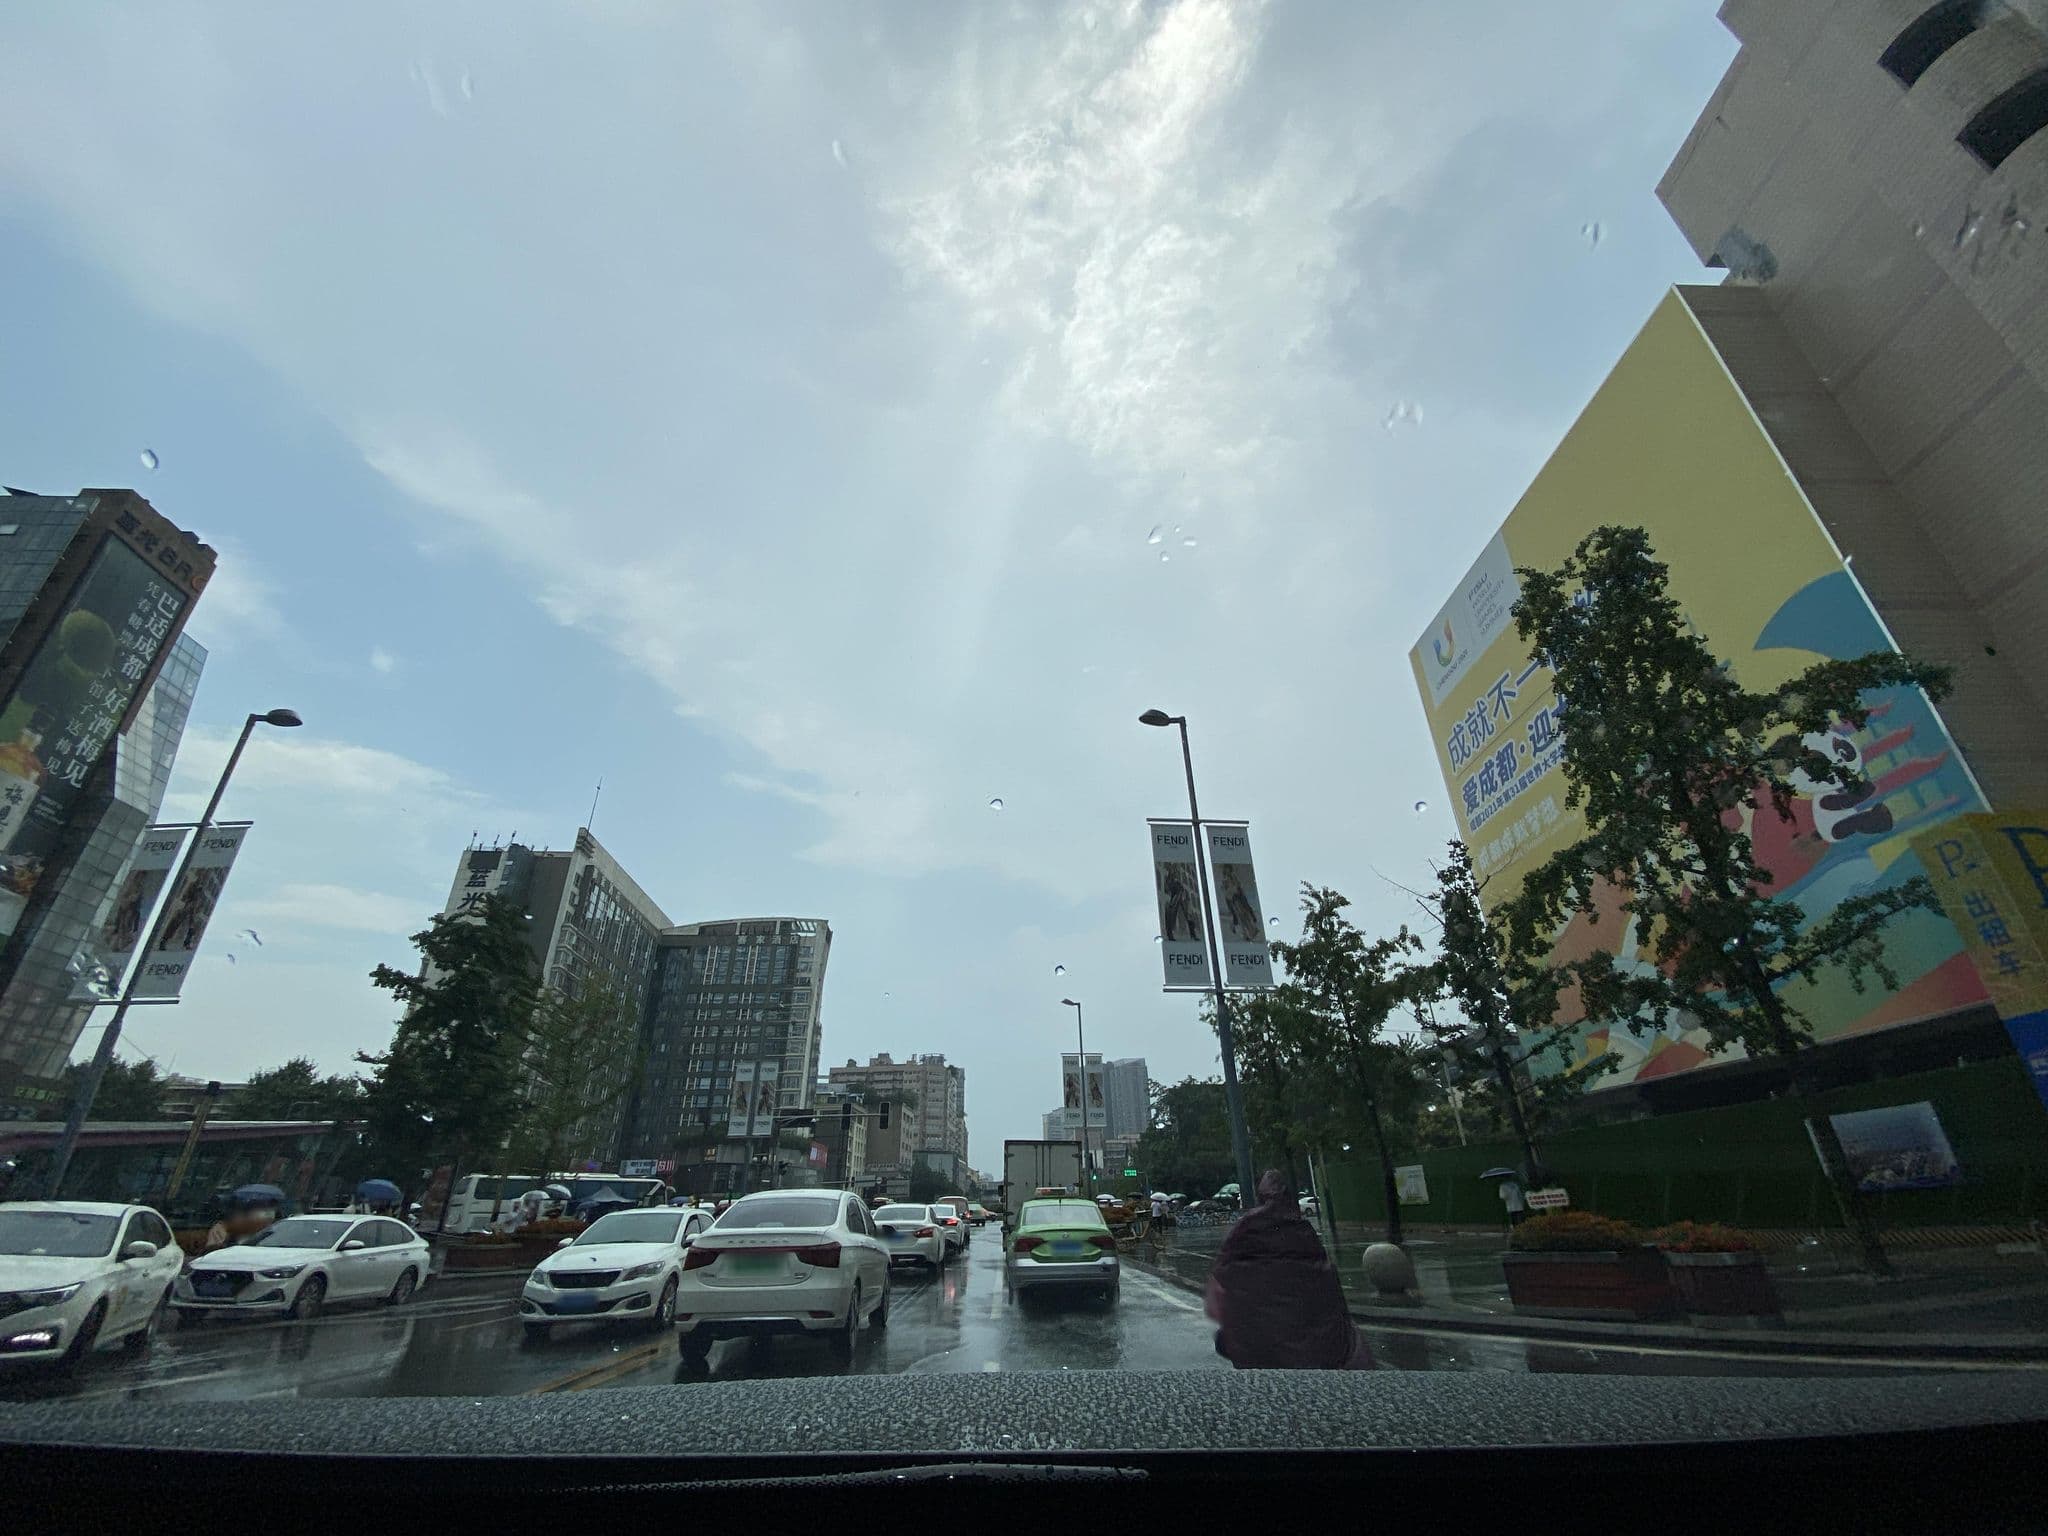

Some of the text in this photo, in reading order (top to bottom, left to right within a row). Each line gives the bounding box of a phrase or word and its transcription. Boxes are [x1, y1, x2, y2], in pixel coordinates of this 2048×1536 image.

[1447, 652, 1558, 773] 成就不一
[145, 841, 177, 850] FENDI
[204, 839, 237, 849] FENDI
[1157, 835, 1188, 845] FENDI
[1213, 836, 1245, 847] FENDI
[457, 868, 492, 910] 蓝光
[1964, 889, 2022, 976] 出租车
[1169, 954, 1203, 965] FENDI
[1231, 954, 1265, 966] FENDI
[147, 964, 185, 976] FENDI
